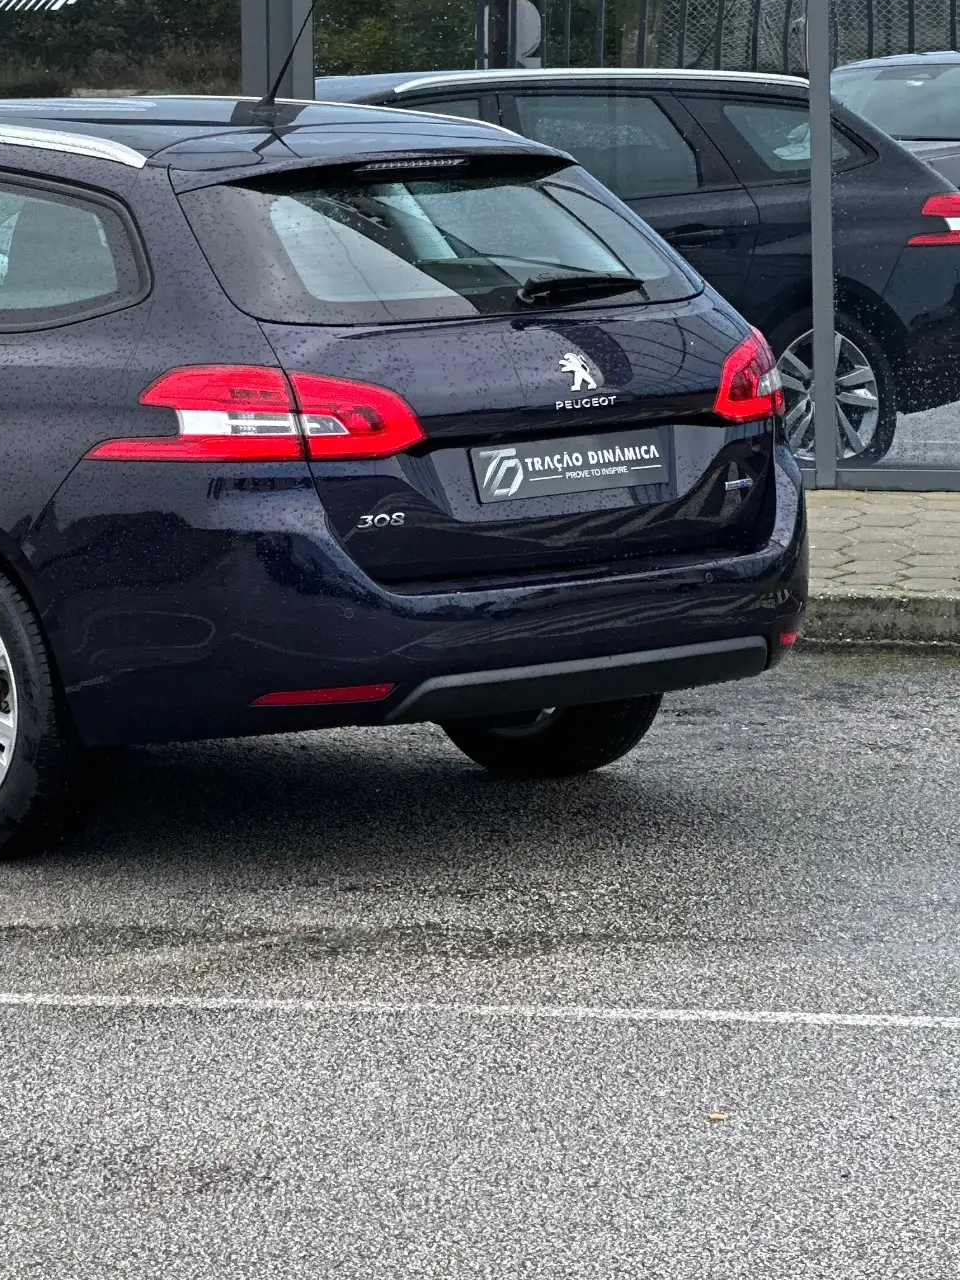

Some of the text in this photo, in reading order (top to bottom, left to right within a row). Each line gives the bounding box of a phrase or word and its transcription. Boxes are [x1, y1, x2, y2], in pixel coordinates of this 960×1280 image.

[555, 396, 617, 410] PEUGEOT
[525, 445, 660, 472] TRAÇÃO DINÂMICA
[565, 465, 628, 479] PROVE TO INSPIRE
[357, 512, 405, 528] 308
